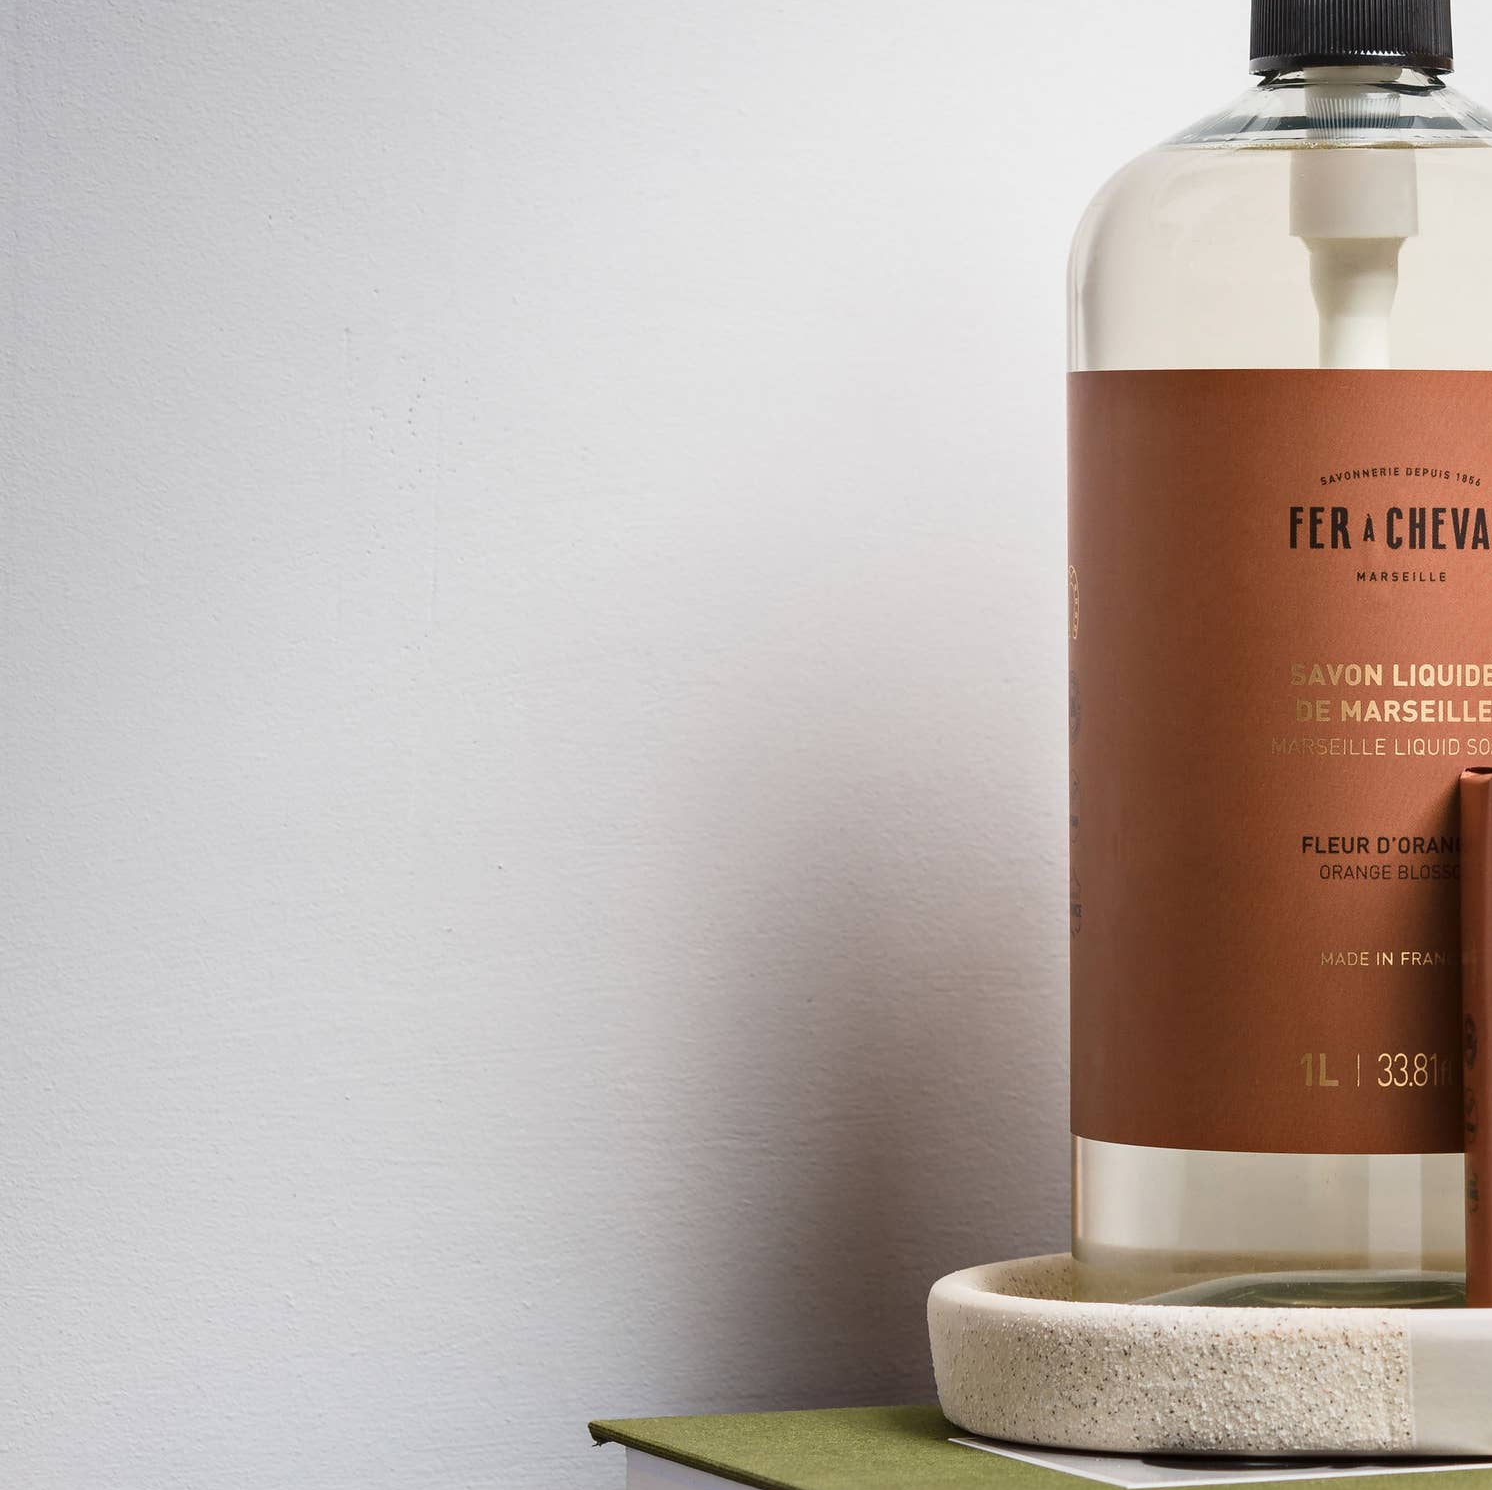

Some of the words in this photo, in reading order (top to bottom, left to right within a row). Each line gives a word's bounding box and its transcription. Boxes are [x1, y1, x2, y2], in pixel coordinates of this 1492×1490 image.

[1320, 467, 1400, 486] SAVONNERIE
[1405, 467, 1451, 481] DEPUIS
[1455, 471, 1482, 488] 1856
[1289, 506, 1352, 550] FER
[1362, 513, 1376, 543] À
[1356, 571, 1447, 583] MARSEILLE
[1289, 664, 1383, 687] SAVON
[1296, 700, 1331, 722] DE
[1341, 700, 1492, 723] MARSEILLE
[1271, 738, 1386, 757] MARSEILLE
[1394, 738, 1460, 756] LIQUID
[1302, 836, 1369, 854] FLEUR
[1319, 865, 1391, 880] ORANGE
[1398, 864, 1461, 880] BLOSSO
[1321, 951, 1369, 966] MADE
[1376, 951, 1393, 966] IN
[1300, 1053, 1339, 1086] 1L
